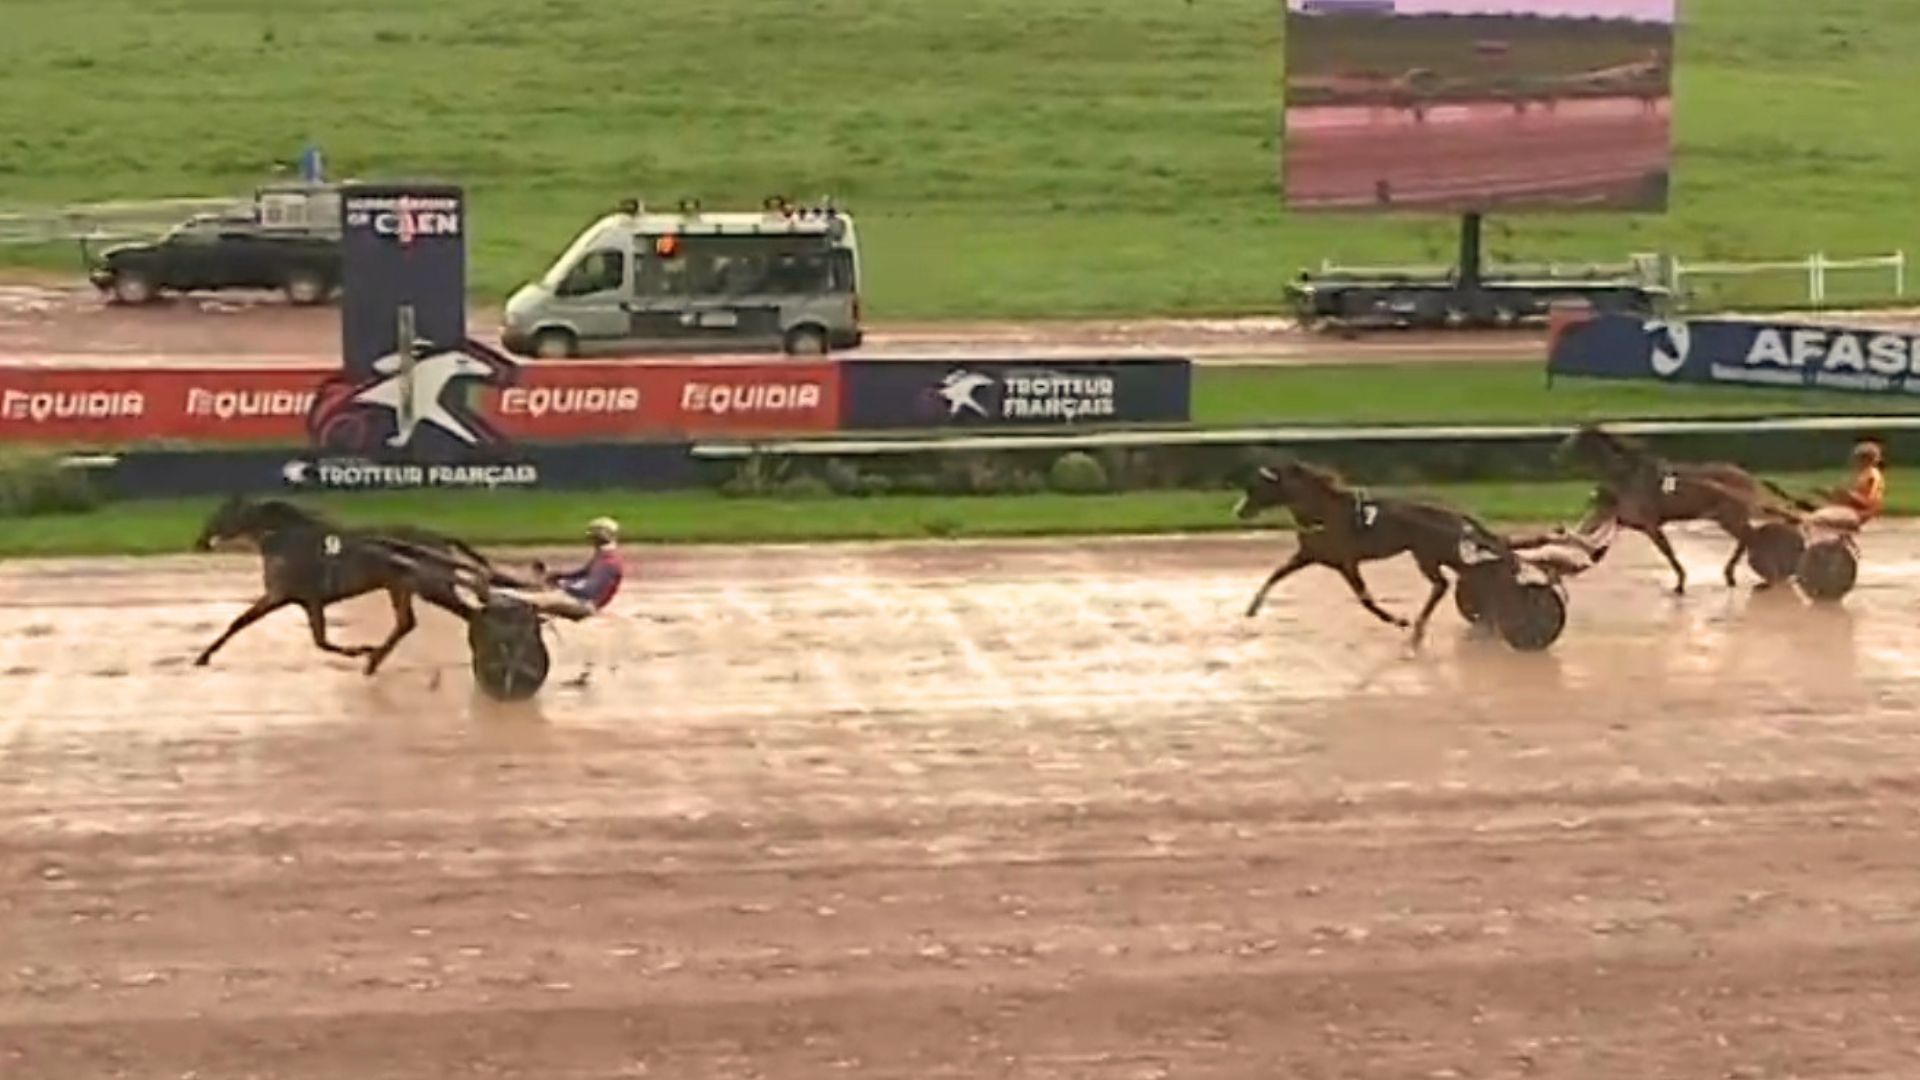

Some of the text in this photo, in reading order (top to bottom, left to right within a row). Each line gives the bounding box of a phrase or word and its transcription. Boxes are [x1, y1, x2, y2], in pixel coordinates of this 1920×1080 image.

[375, 212, 458, 236] CAEN
[1003, 377, 1114, 396] TROTTEUR
[2, 389, 145, 419] EQUIDIA
[502, 387, 640, 416] EQUIDIA
[681, 383, 821, 414] EQUIDIA
[1003, 397, 1115, 420] FRANÇAIS
[319, 463, 424, 483] TROTTEUR
[1363, 505, 1379, 526] 7
